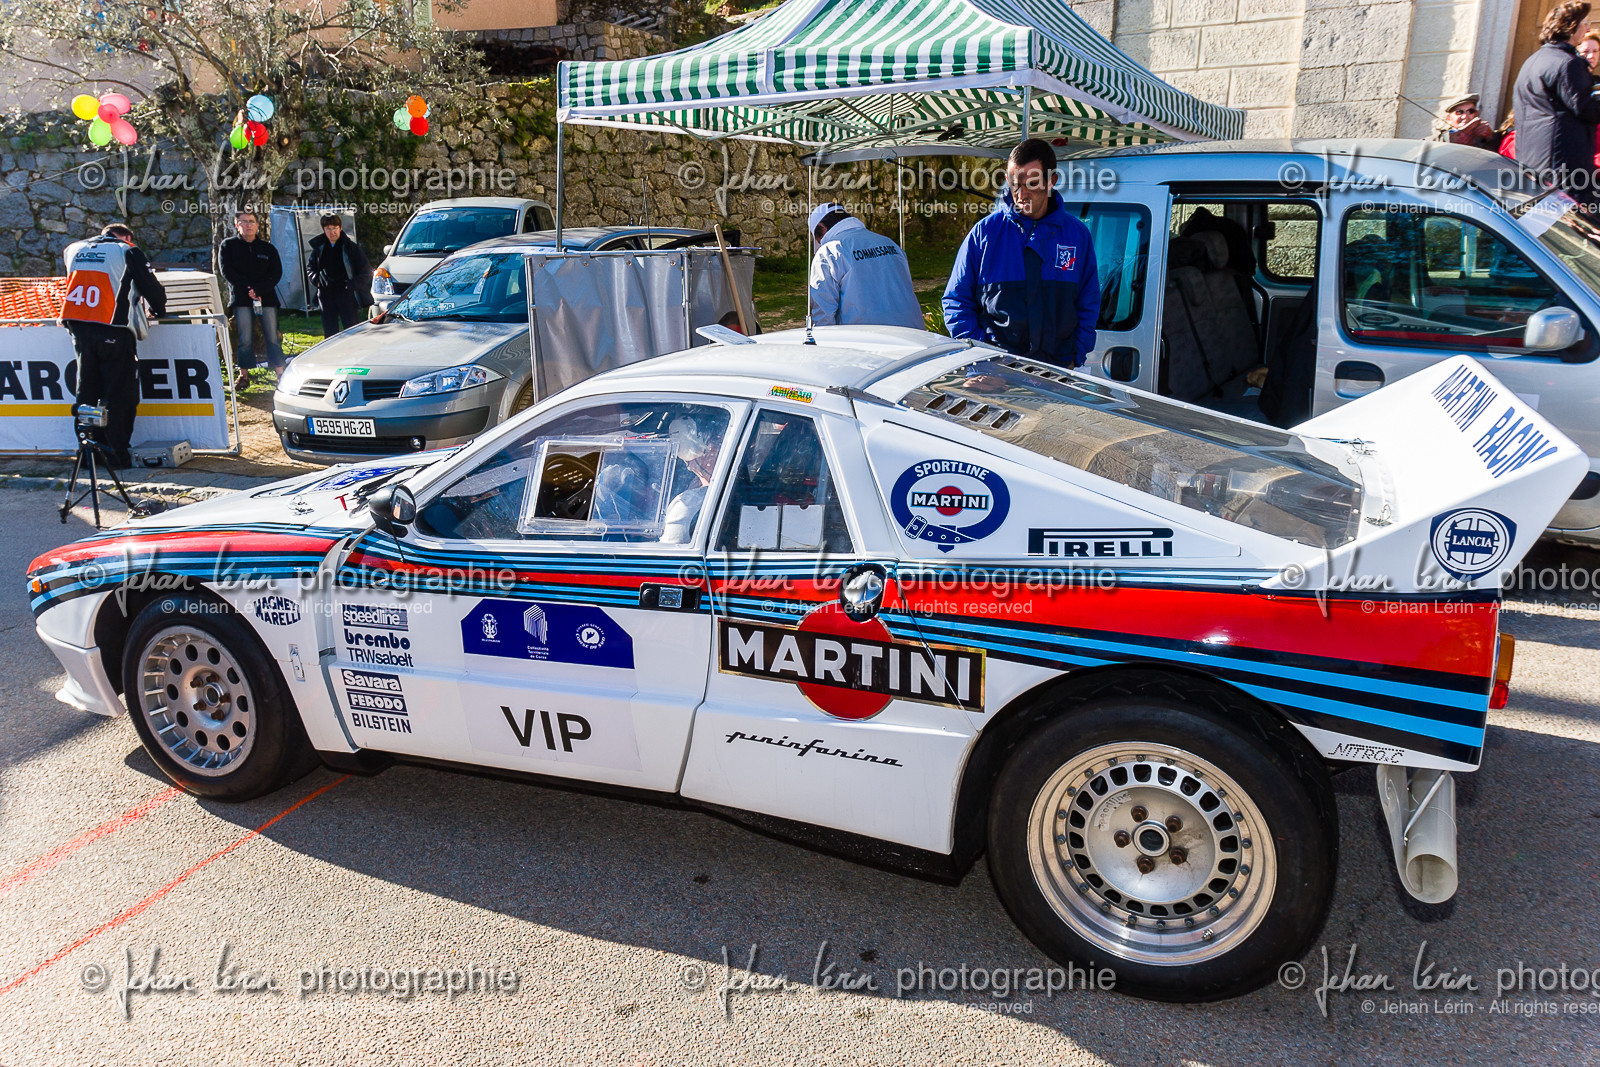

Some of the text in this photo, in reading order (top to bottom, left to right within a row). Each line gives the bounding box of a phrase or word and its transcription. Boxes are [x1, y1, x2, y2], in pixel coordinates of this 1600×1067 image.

[853, 245, 898, 261] COMMISSAIRE
[66, 285, 100, 308] 40
[1431, 364, 1498, 433] MARTINI
[914, 461, 990, 481] SPORTLINE
[913, 493, 986, 508] MARTINI
[1028, 528, 1174, 557] PIRELLI
[1452, 535, 1492, 547] LANCIA
[343, 608, 400, 625] speedline
[344, 628, 411, 650] brembo
[728, 626, 971, 701] MARTINI
[343, 670, 401, 690] Savara
[349, 693, 404, 710] FERODO
[351, 712, 412, 733] BILSTEIN
[500, 705, 592, 753] VIP
[725, 731, 903, 767] pininfarina
